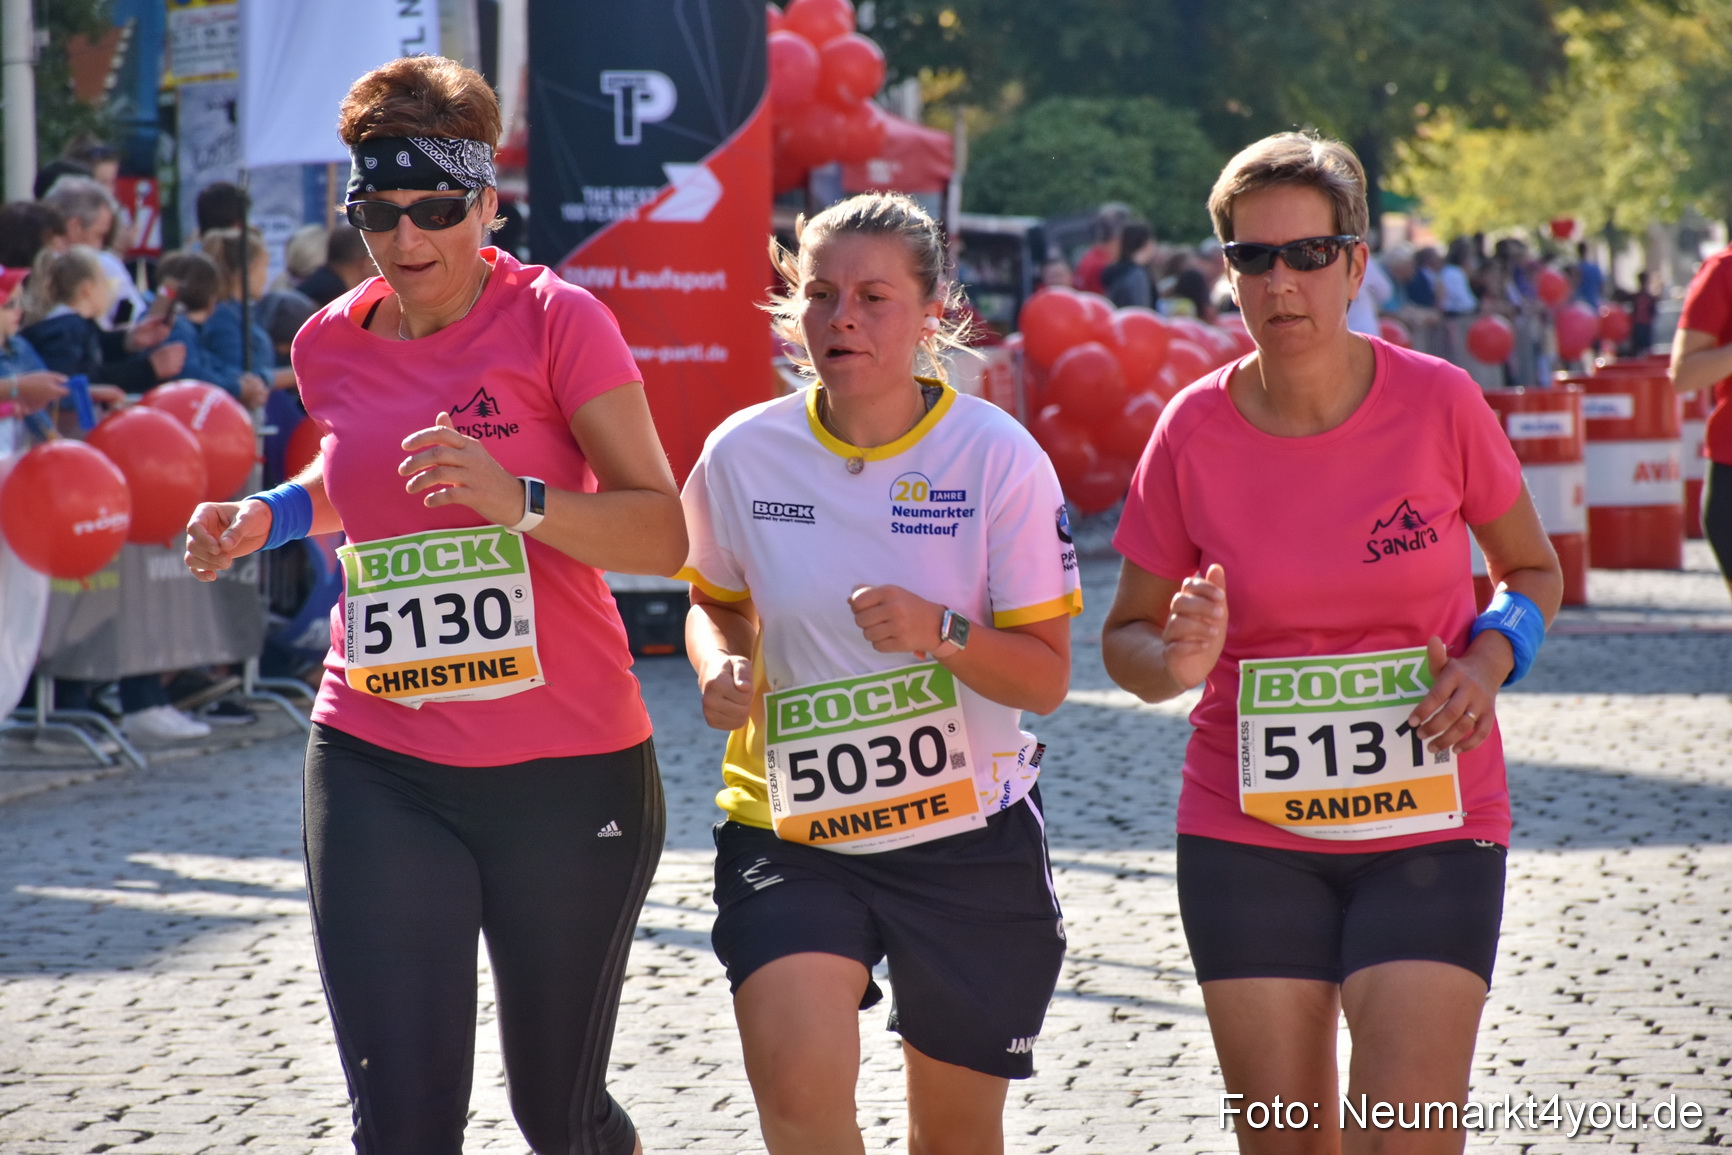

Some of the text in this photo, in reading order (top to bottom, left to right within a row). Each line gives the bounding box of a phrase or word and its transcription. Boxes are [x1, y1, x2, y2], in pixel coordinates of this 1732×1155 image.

[582, 186, 658, 201] THE NEXT
[562, 267, 727, 293] BMW Laufsport
[894, 481, 964, 502] 20 JAHRE
[753, 500, 815, 519] BOCK
[891, 505, 975, 518] Neumarkter
[891, 521, 959, 537] Stadtlauf
[359, 535, 508, 587] BOCK
[364, 588, 512, 654] 5130
[514, 589, 524, 599] S
[365, 657, 519, 694] CHRISTINE
[1256, 659, 1426, 706] BOCK
[779, 671, 941, 734] BOCK
[788, 725, 947, 803] 5030
[947, 723, 957, 734] S
[1264, 721, 1425, 781] 5131
[809, 793, 949, 842] ANNETTE
[1285, 789, 1417, 821] SANDRA
[597, 830, 622, 838] adidas
